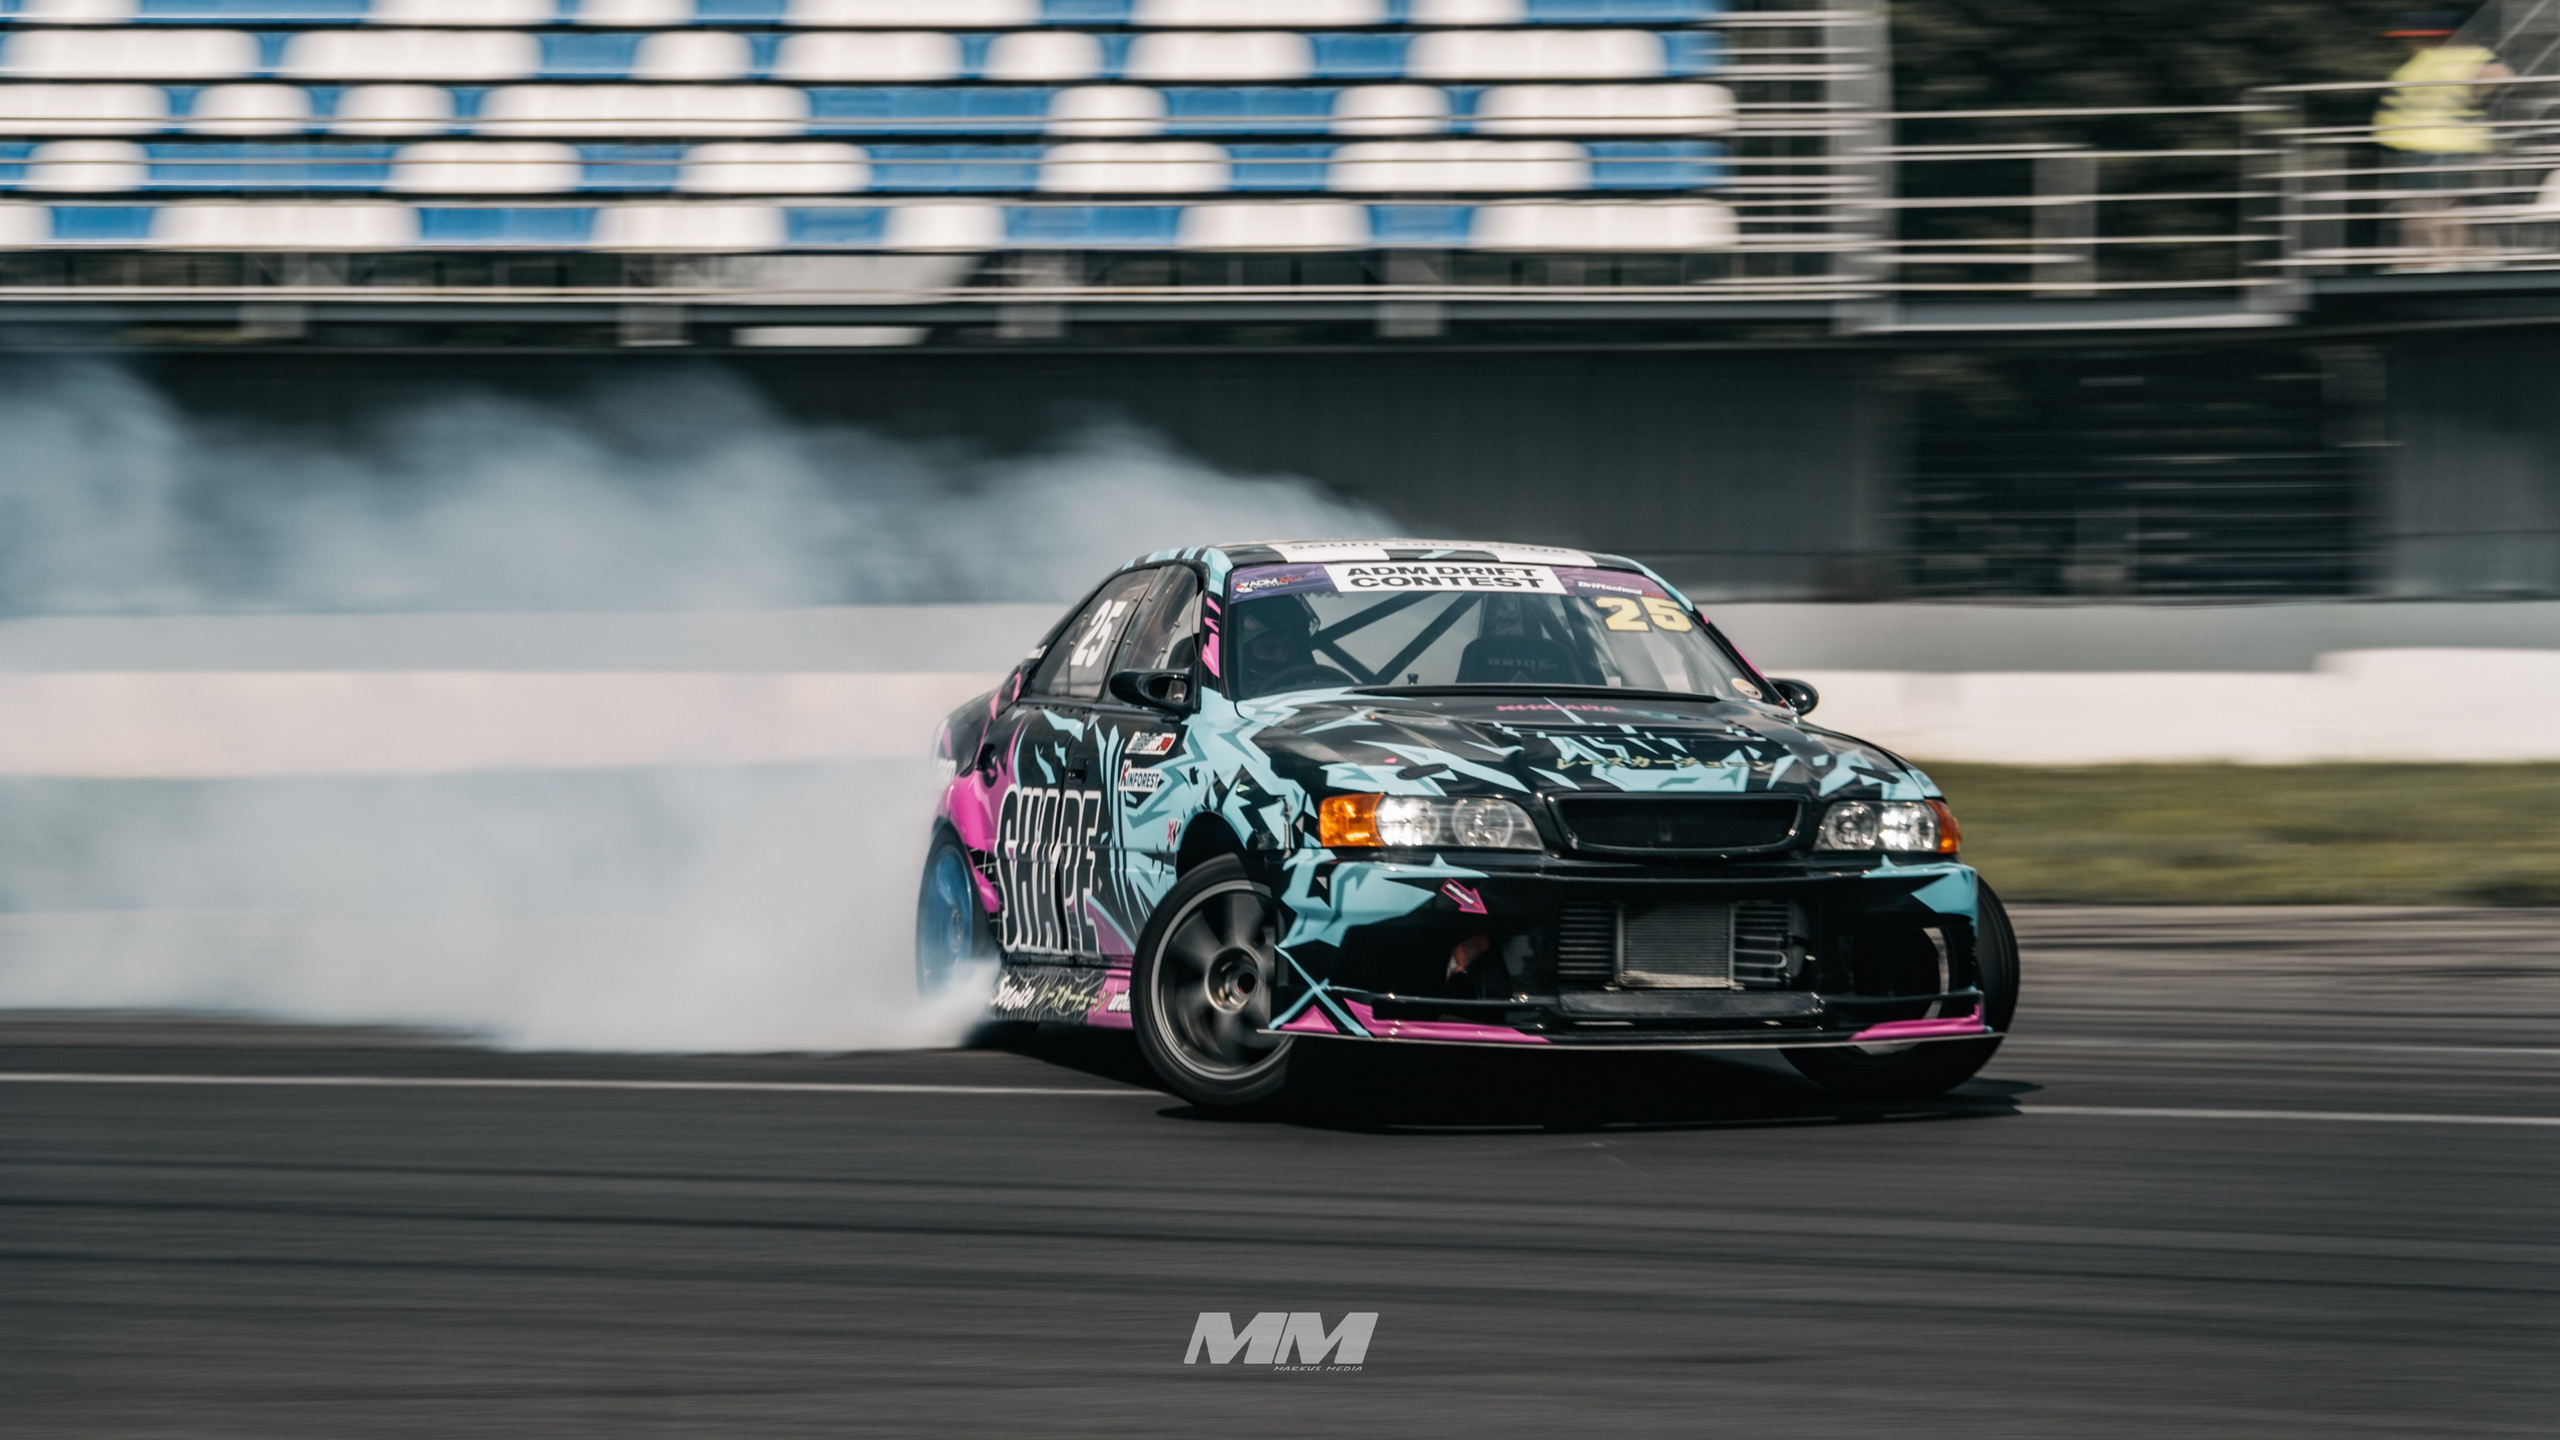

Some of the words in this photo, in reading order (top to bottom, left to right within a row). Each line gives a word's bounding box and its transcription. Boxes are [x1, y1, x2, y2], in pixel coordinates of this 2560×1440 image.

[1348, 567, 1427, 576] ADM
[1435, 567, 1537, 577] DRIFT
[1350, 576, 1543, 588] CONTEST
[1595, 596, 1692, 632] 25
[1070, 599, 1128, 668] 25
[1120, 763, 1160, 788] KINFOREST
[995, 783, 1102, 954] SHAPE
